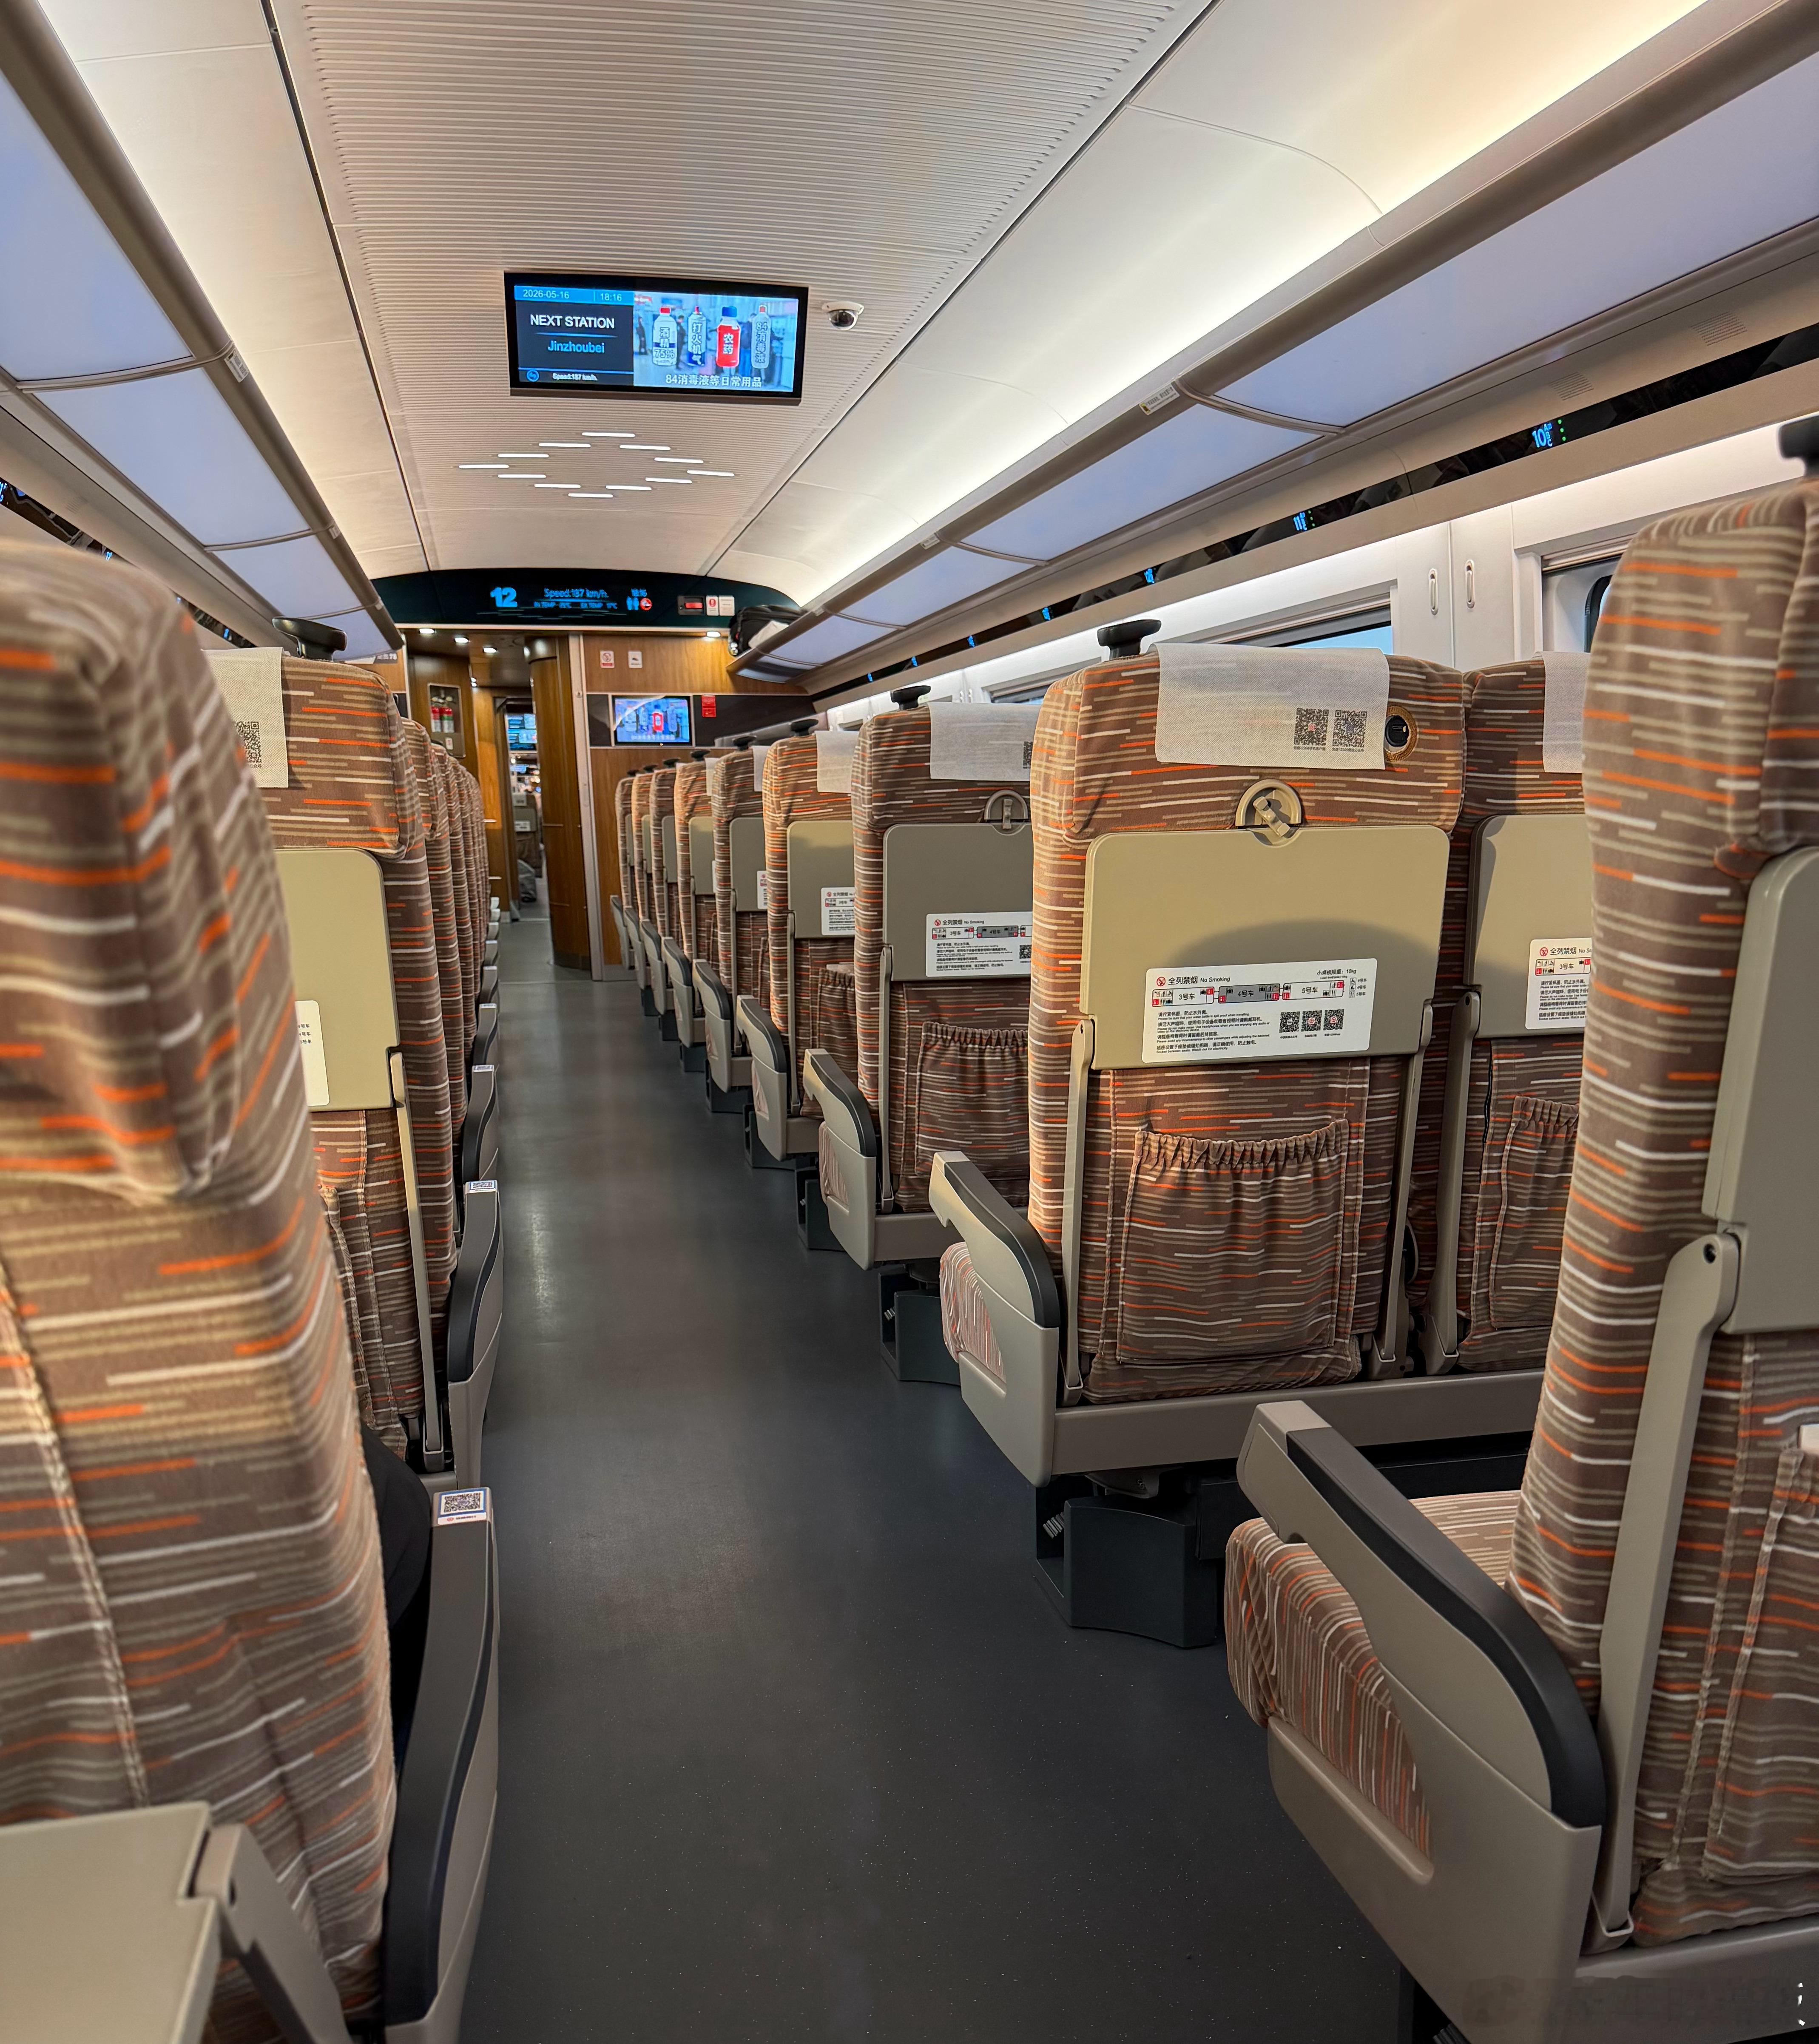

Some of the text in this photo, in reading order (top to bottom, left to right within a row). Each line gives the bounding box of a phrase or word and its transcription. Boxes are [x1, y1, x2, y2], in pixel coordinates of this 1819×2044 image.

[523, 289, 622, 301] 2026-05-16 18:16
[530, 314, 615, 329] NEXT STATION
[547, 340, 605, 353] Jinzhoubei
[723, 333, 734, 354] 农药
[654, 349, 675, 359] 75%
[665, 374, 762, 387] 84消毒液等日常用品
[1532, 429, 1546, 448] 10
[1545, 431, 1551, 439] B
[1548, 439, 1552, 447] C
[490, 587, 517, 607] 12
[1550, 947, 1577, 955] 全列禁烟
[1168, 976, 1198, 985] 全列禁烟
